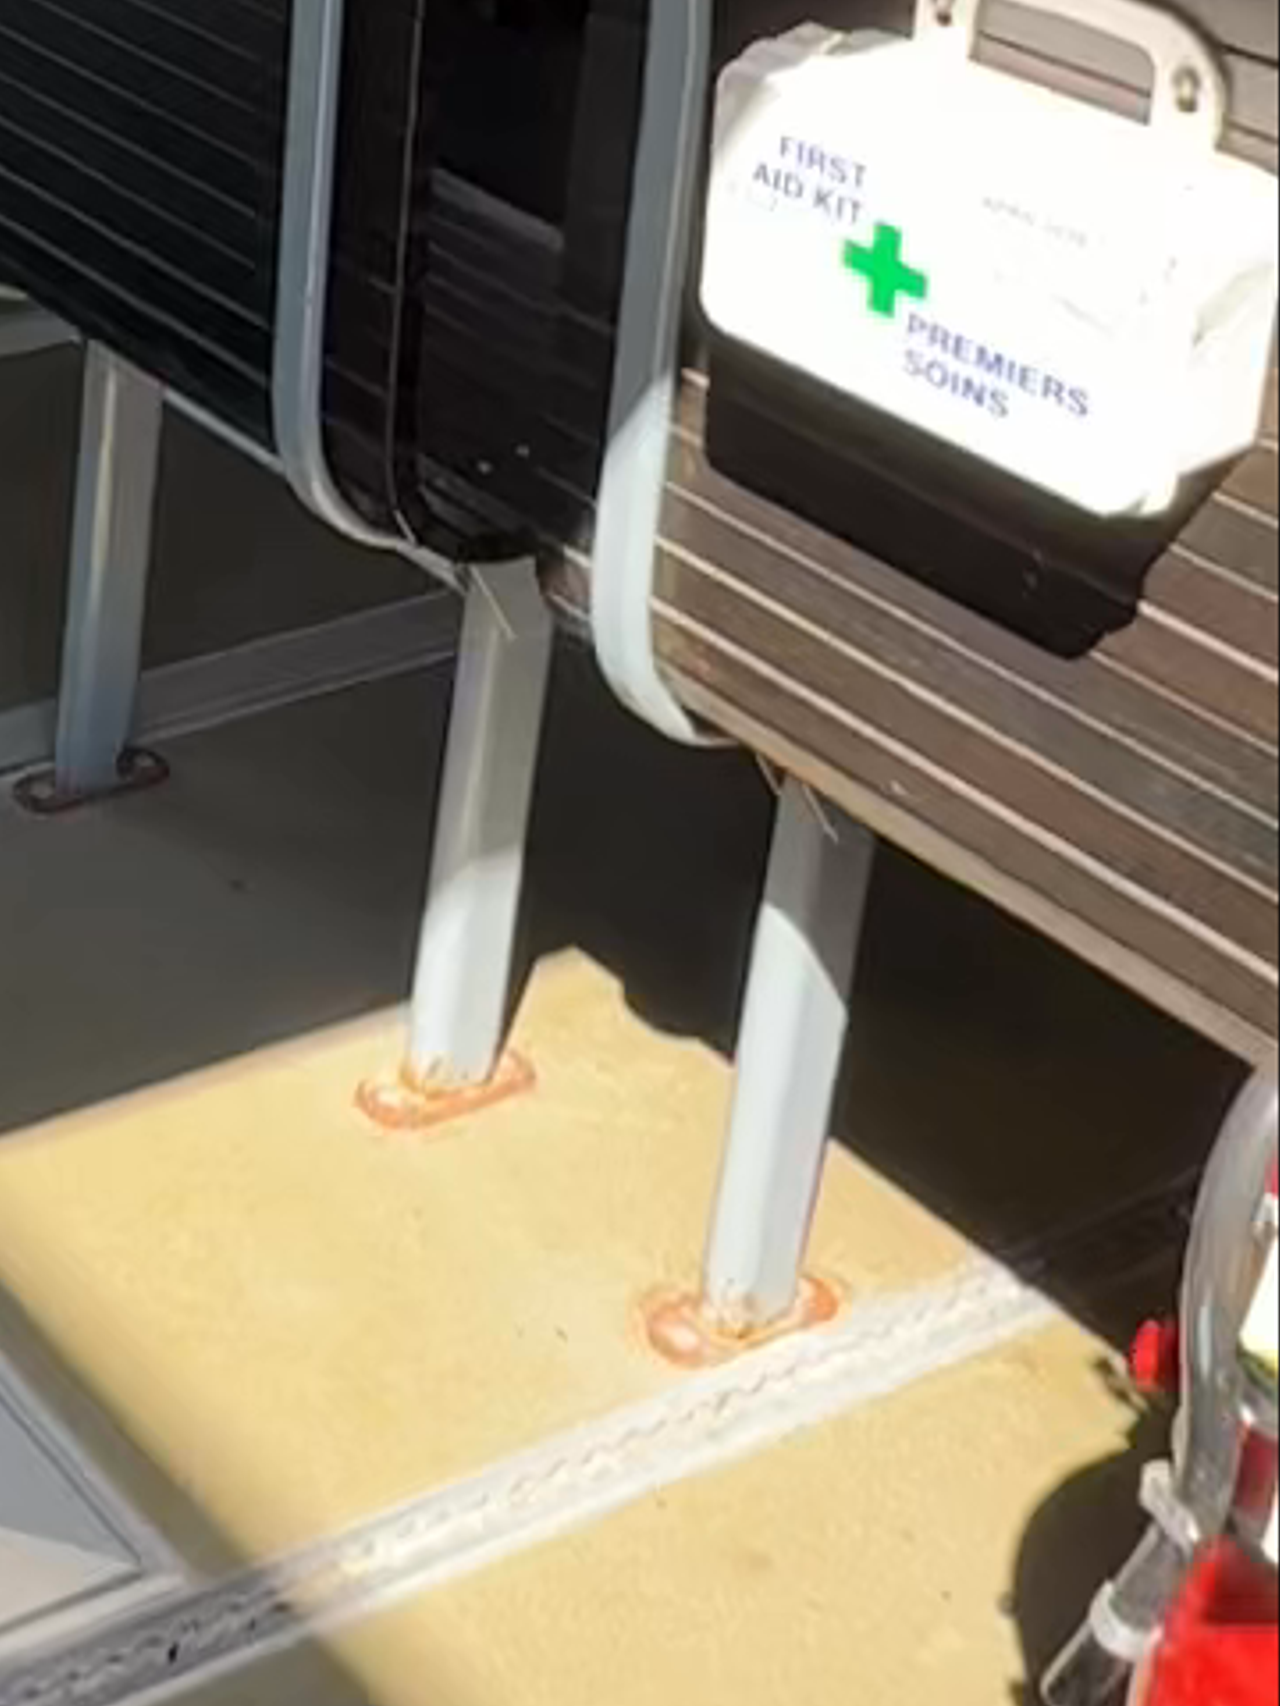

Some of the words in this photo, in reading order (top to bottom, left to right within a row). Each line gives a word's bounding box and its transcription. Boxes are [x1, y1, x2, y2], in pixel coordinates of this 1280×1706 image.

[752, 162, 804, 199] AID
[813, 185, 862, 225] KIT
[779, 135, 866, 188] FIRST
[903, 348, 1009, 418] SOINS
[907, 312, 1089, 417] PREMIERS
